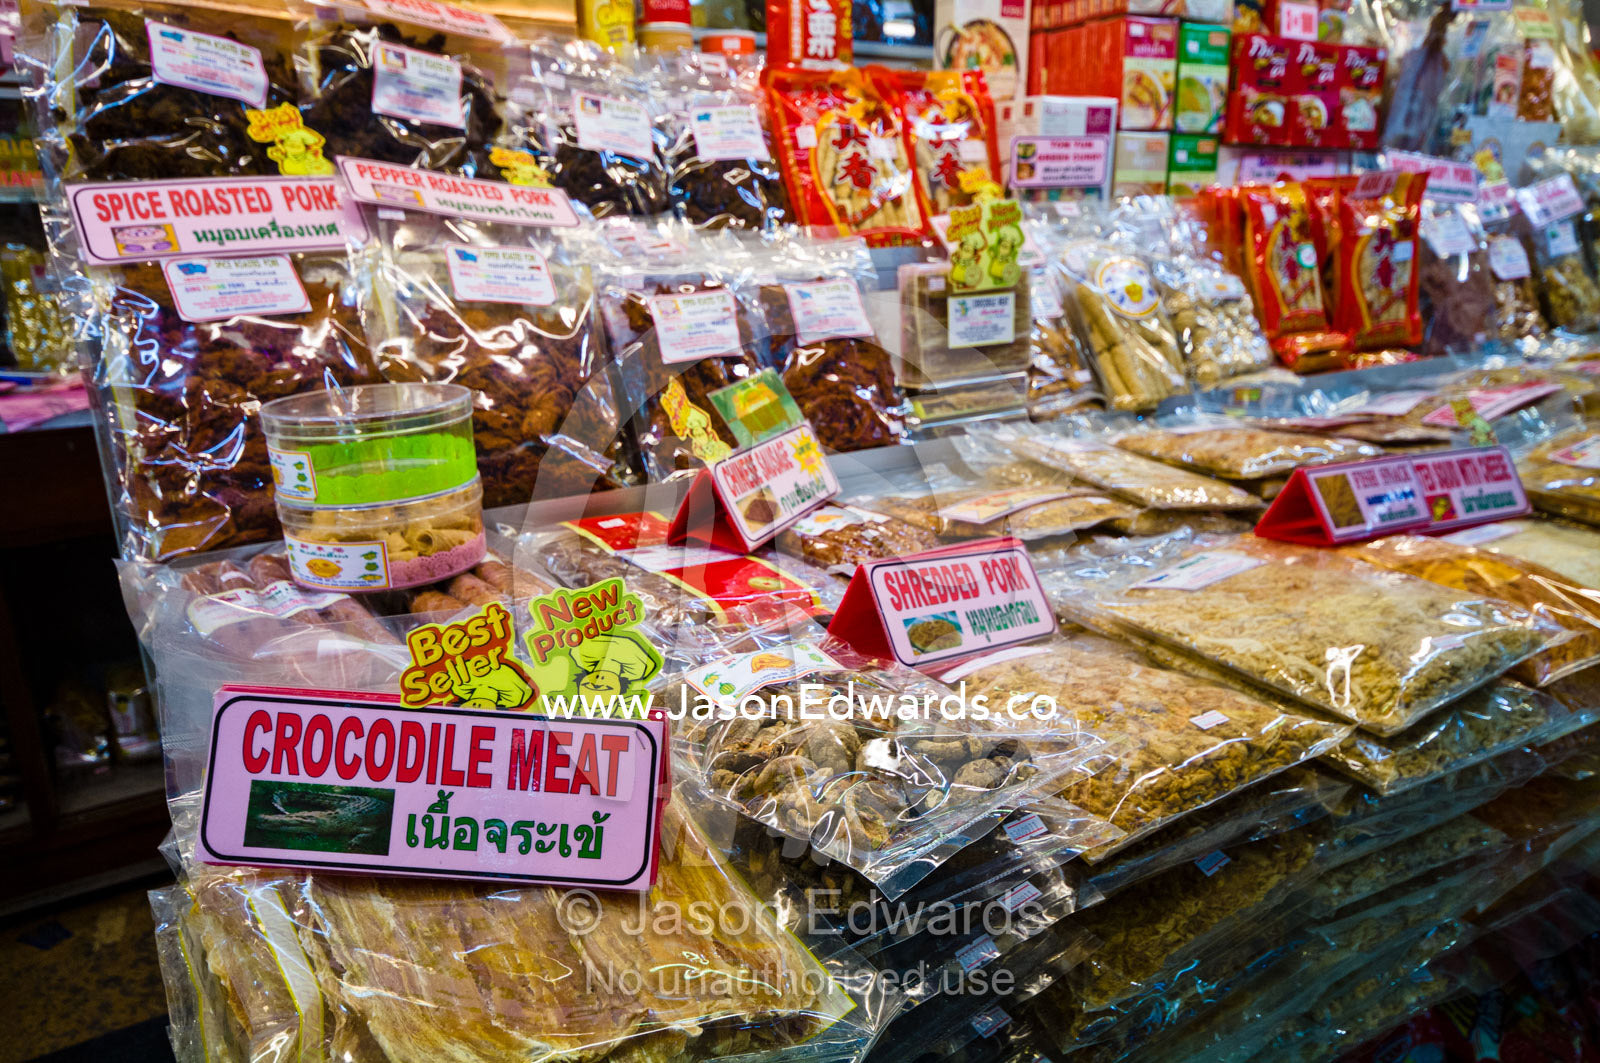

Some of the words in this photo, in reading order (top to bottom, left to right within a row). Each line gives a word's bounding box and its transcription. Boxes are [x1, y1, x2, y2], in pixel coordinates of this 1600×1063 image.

[93, 190, 167, 223] SPICE
[167, 186, 273, 218] ROASTED
[281, 184, 343, 212] PORK
[356, 164, 425, 190] PEPPER
[427, 174, 504, 202] ROASTED
[510, 188, 556, 207] PORK
[192, 218, 340, 246] หมูอบเครื่องเทศ
[538, 583, 619, 632] New
[883, 563, 981, 612] SHREDDED
[984, 555, 1030, 594] PORK
[411, 605, 508, 668] Best
[403, 646, 504, 704] Seller
[242, 709, 496, 789] CROCODILE
[507, 727, 630, 797] MEAT
[405, 789, 612, 860] เนื้อจระเข้
